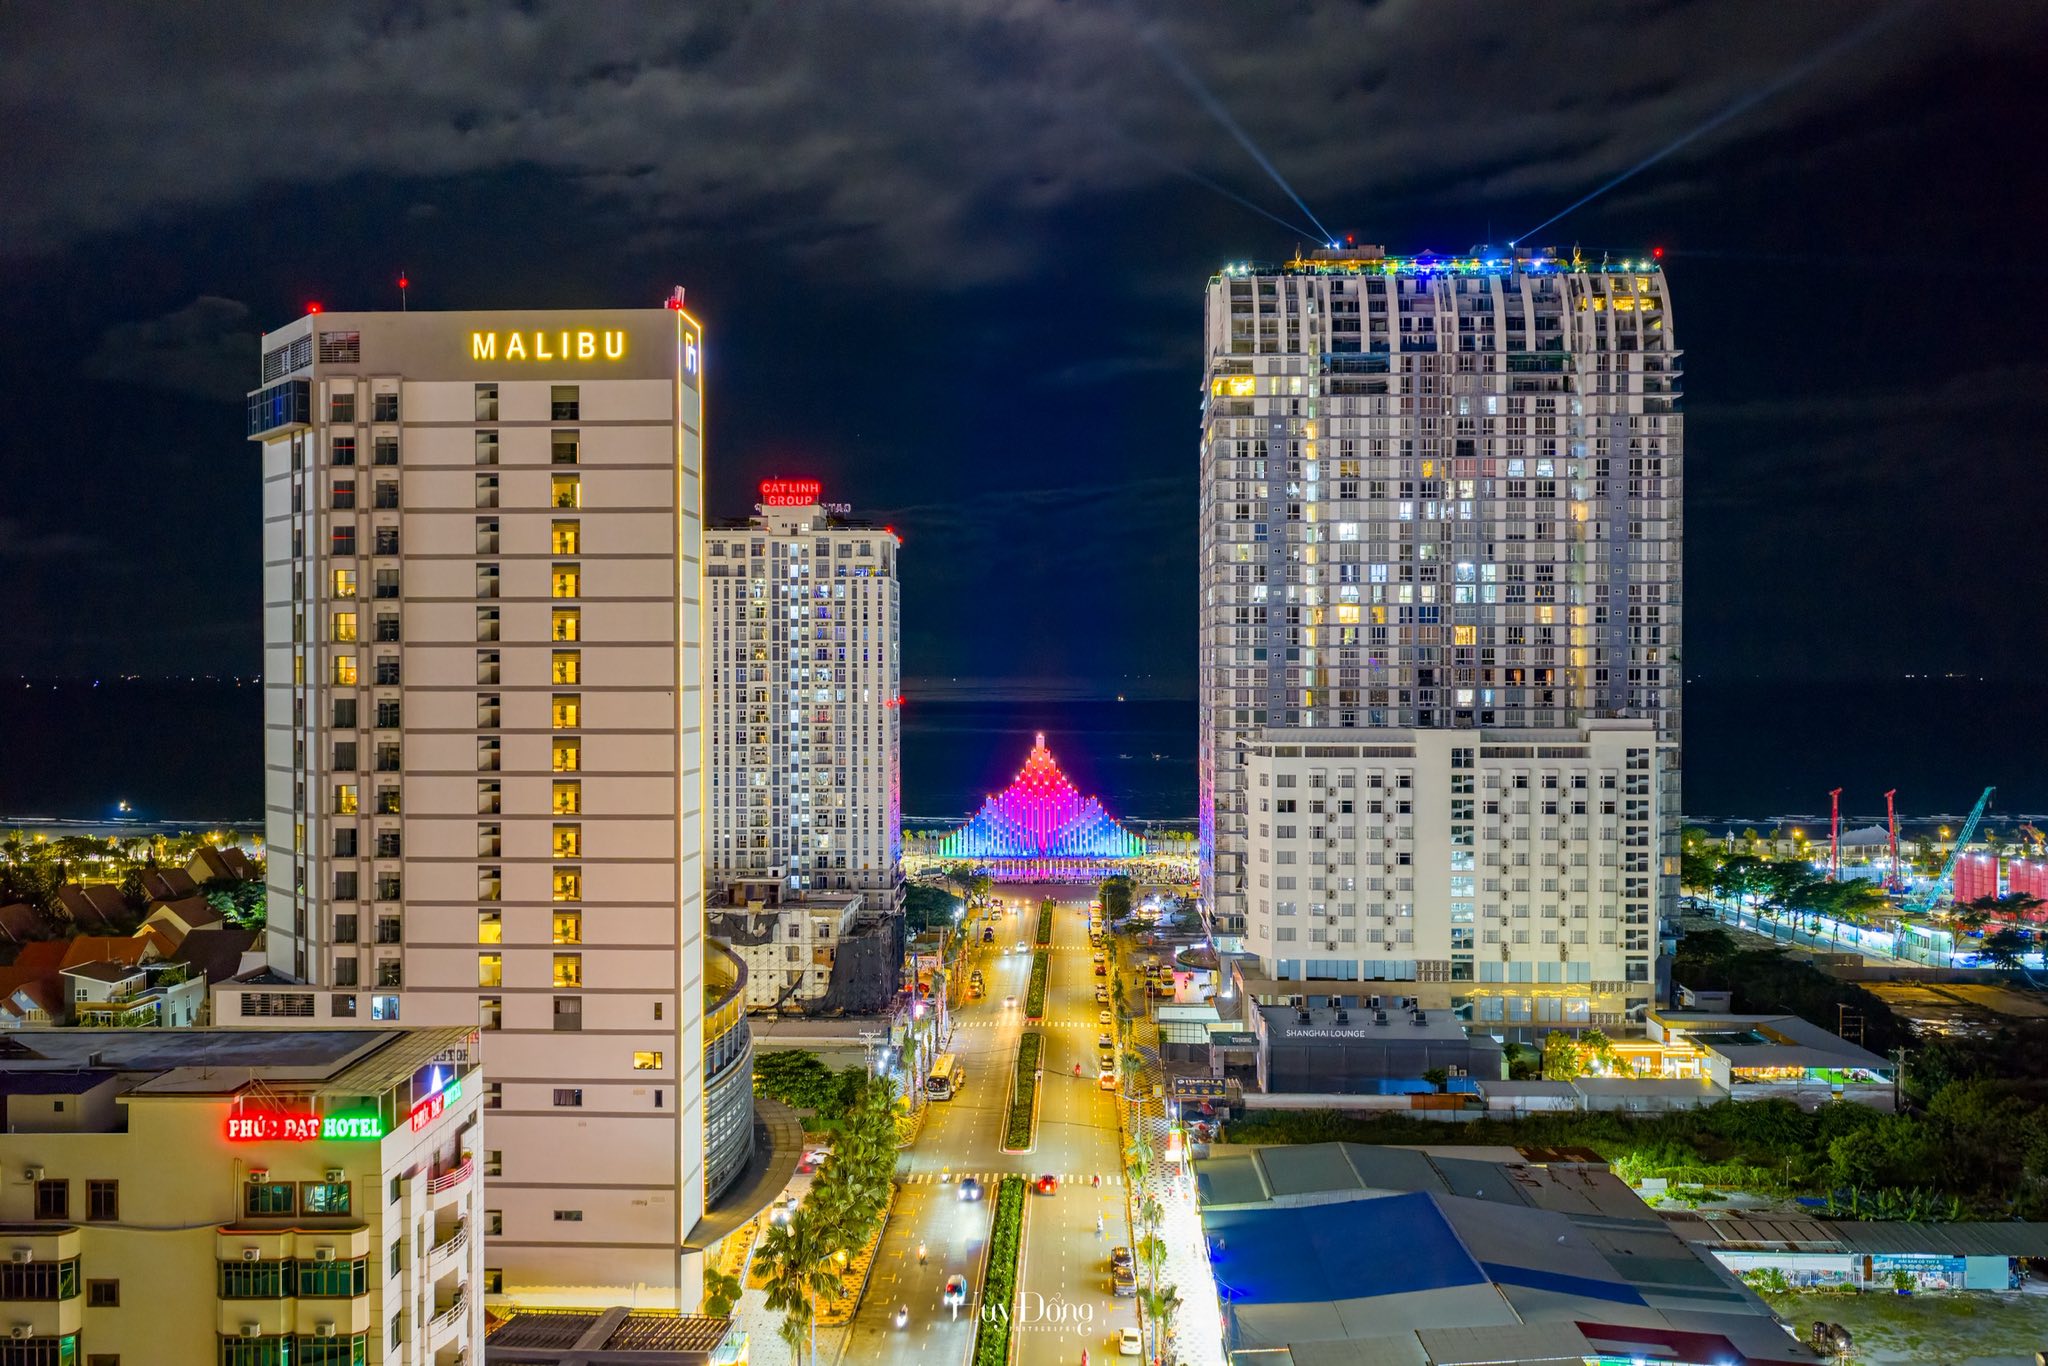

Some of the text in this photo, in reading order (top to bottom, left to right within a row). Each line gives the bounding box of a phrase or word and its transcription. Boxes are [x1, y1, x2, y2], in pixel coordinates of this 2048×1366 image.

[472, 331, 624, 360] MALIBU
[789, 483, 819, 493] LINH
[768, 495, 813, 505] GROUP
[1286, 1029, 1365, 1038] SHANGHAI LOUNGE
[323, 1118, 382, 1137] HOTEL
